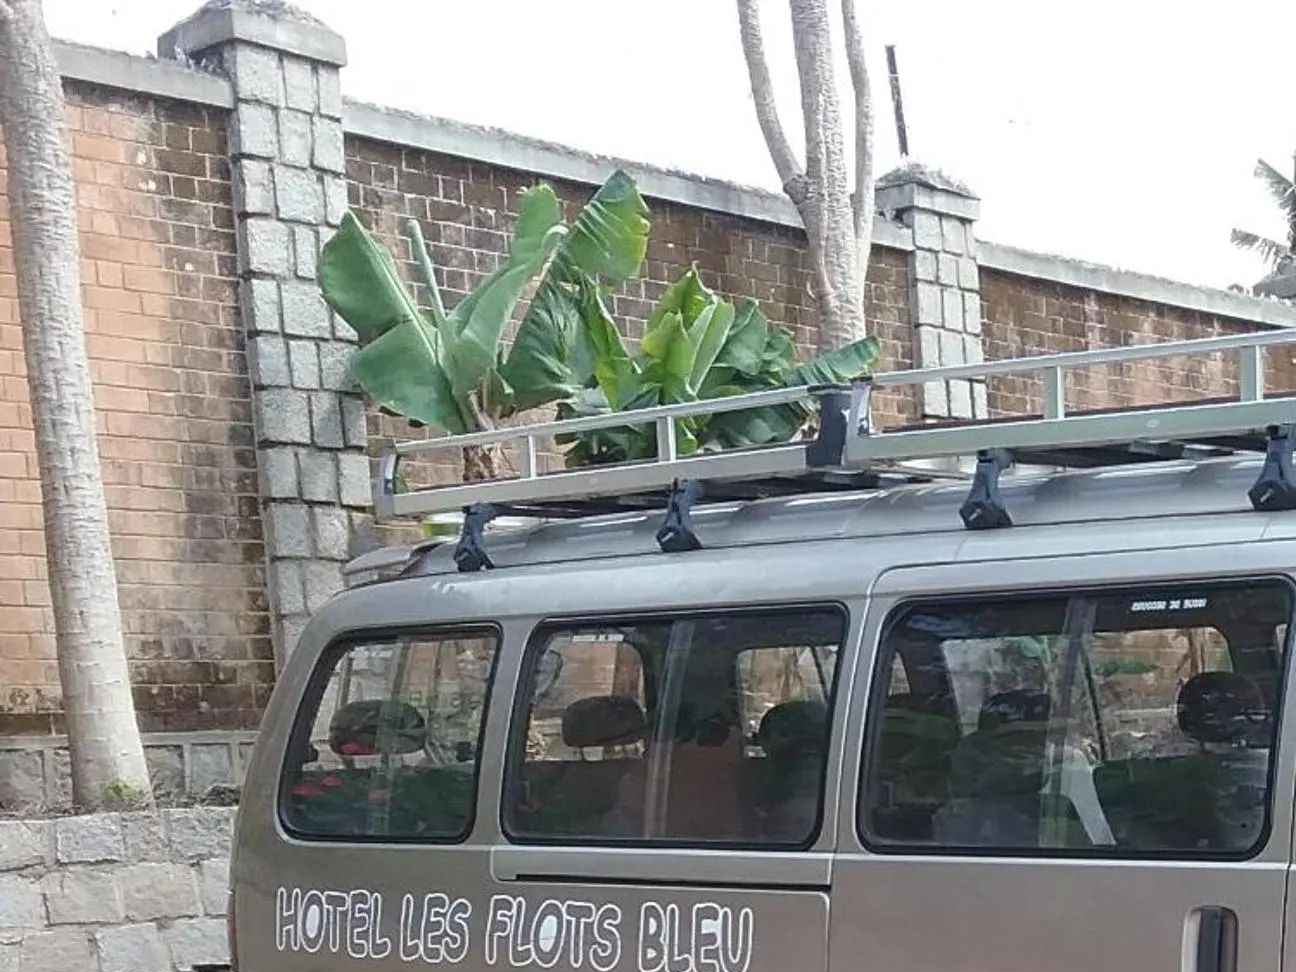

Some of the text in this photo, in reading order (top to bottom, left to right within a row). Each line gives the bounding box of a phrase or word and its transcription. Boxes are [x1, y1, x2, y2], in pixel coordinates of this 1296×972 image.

[275, 886, 391, 959] HOTEL
[400, 893, 472, 963] LES
[485, 895, 622, 971] FLOTS
